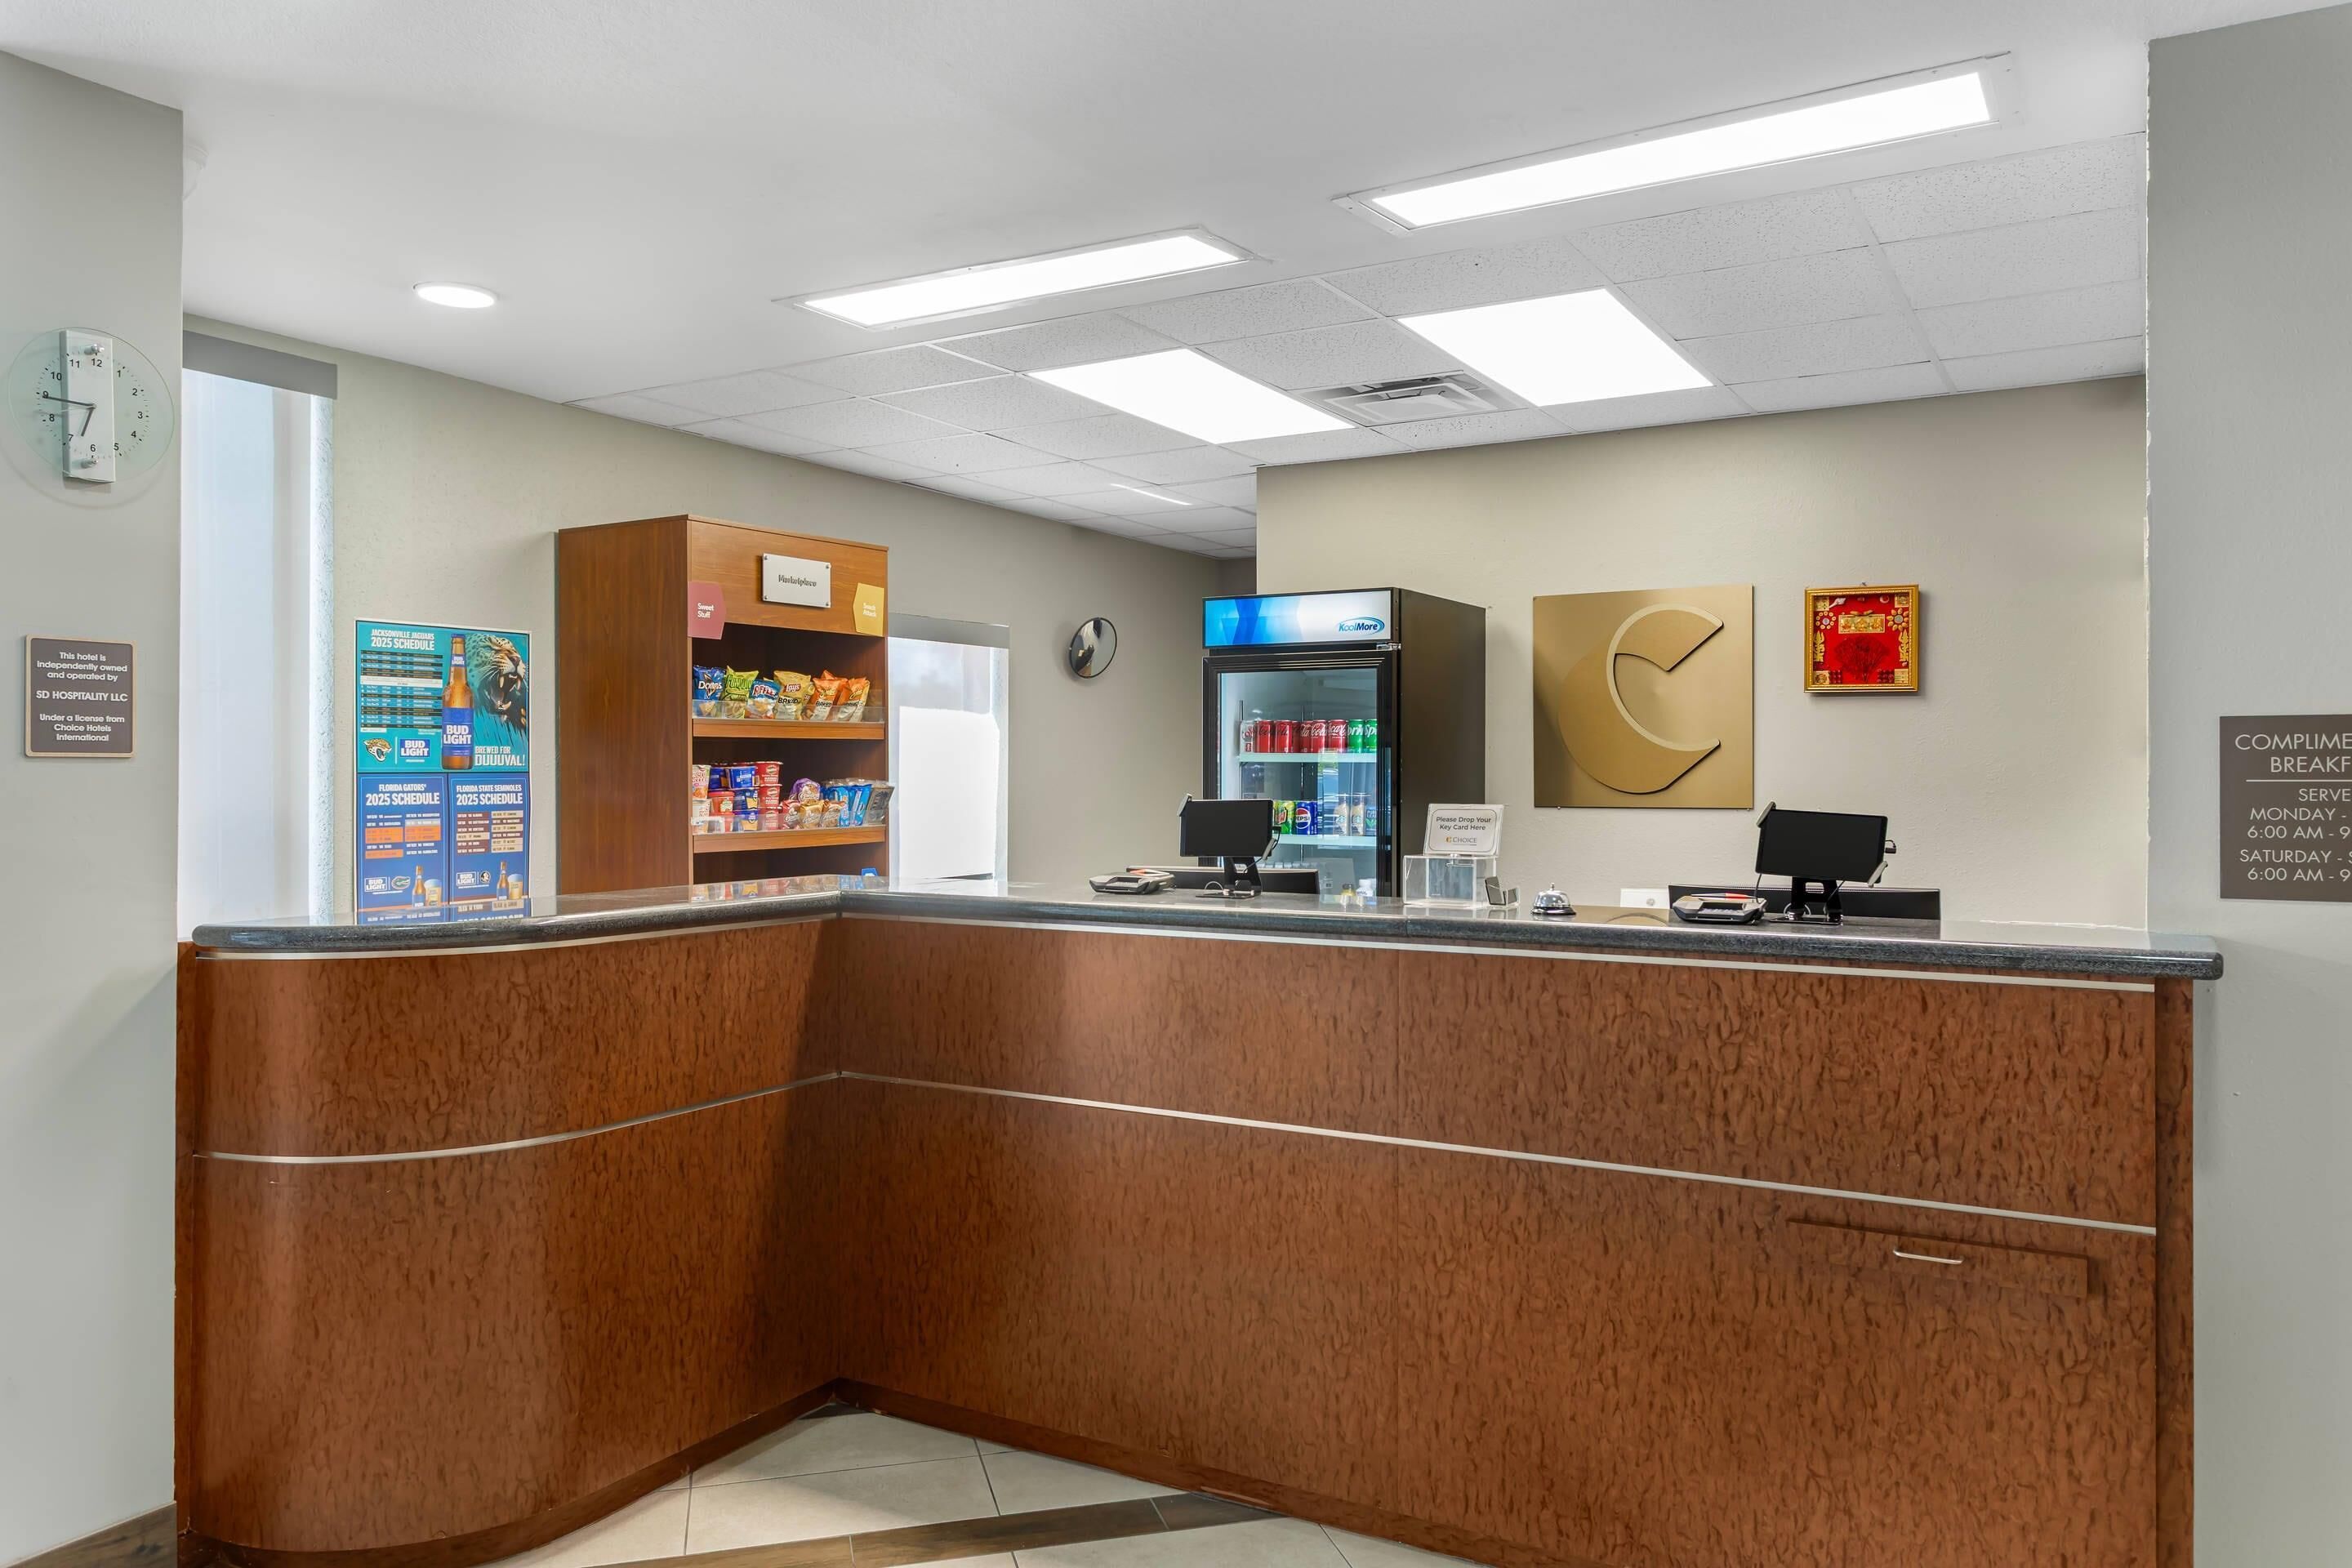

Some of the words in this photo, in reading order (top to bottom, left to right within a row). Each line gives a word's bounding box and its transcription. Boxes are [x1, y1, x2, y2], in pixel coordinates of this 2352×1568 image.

[69, 359, 80, 368] 11
[91, 359, 103, 368] 12
[51, 372, 62, 381] 10
[117, 370, 122, 378] 1
[42, 390, 49, 399] 9
[132, 388, 138, 396] 2
[49, 413, 56, 422] 8
[68, 434, 74, 442] 7
[131, 430, 137, 439] 4
[90, 443, 96, 452] 6
[114, 443, 119, 451] 5
[778, 574, 817, 587] Marketplace
[697, 603, 715, 612] Sweet
[1339, 622, 1378, 631] KoolMore
[372, 629, 411, 639] JACKSONVILLE
[371, 637, 393, 648] 2025
[394, 639, 435, 651] SCHEDULE
[59, 652, 75, 660] This
[77, 653, 98, 661] hotel
[37, 661, 99, 672] independently
[66, 672, 105, 680] operated
[107, 673, 118, 682] by
[36, 690, 50, 699] SD
[52, 691, 109, 702] HOSPITALITY
[110, 693, 129, 702] LLC
[54, 724, 85, 732] Choice
[446, 725, 470, 734] BUD
[56, 733, 109, 742] International
[443, 735, 472, 745] LIGHT
[2235, 733, 2352, 751] COMPLIME
[404, 740, 425, 748] BUD
[401, 747, 429, 756] LIGHT
[474, 746, 499, 754] BREWED
[474, 754, 525, 766] DUUUVAL!
[2270, 756, 2352, 773] BREAKF
[366, 794, 390, 806] 2025
[391, 793, 440, 805] SCHEDULE
[457, 794, 479, 806] 2025
[479, 793, 523, 805] SCHEDULE
[2298, 788, 2352, 802] SERVE
[2249, 808, 2336, 821] MONDAY
[2247, 826, 2287, 839] 6:00
[2293, 826, 2323, 840] AM
[2239, 849, 2332, 863] SATURDAY
[2247, 867, 2287, 880] 6:00
[2293, 868, 2324, 881] AM
